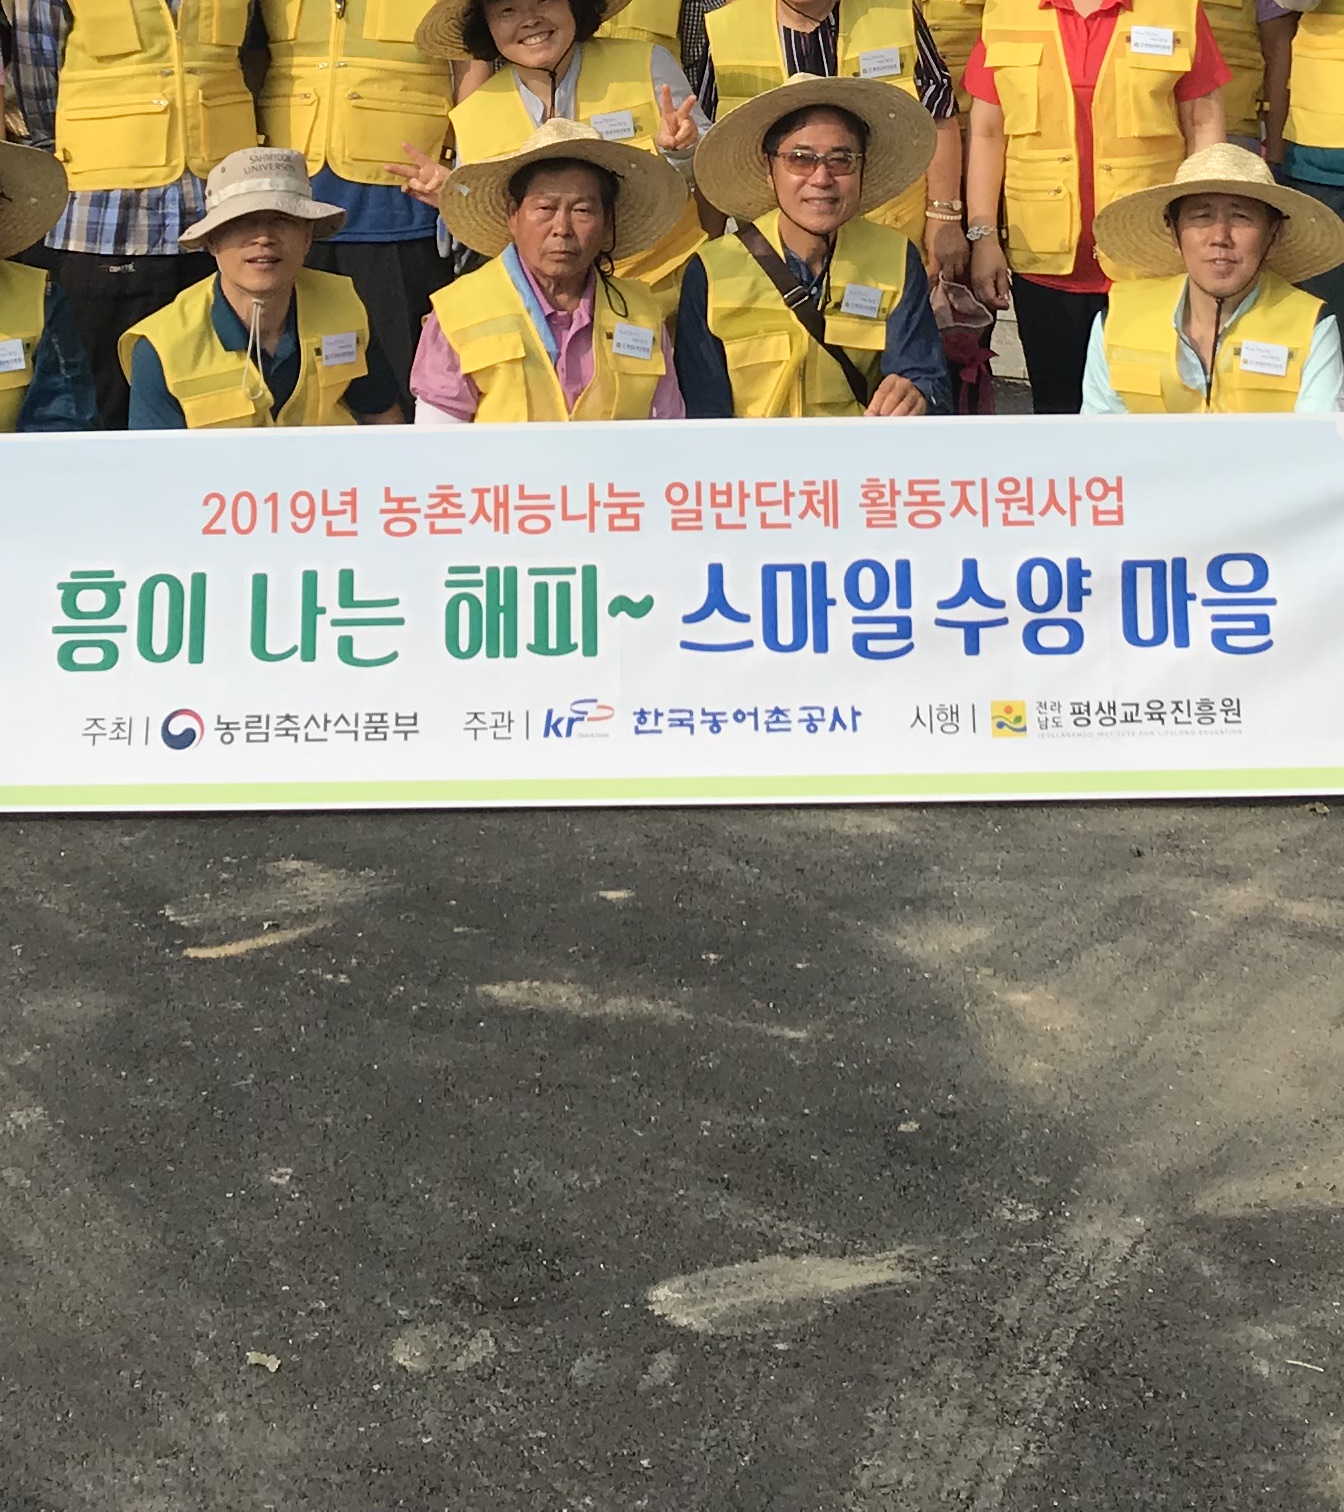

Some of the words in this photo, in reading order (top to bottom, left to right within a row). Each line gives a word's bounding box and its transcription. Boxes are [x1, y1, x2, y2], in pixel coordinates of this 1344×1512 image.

[202, 487, 358, 536] 2019년
[380, 483, 645, 537] 농촌재능나눔
[665, 479, 838, 531] 일반단체
[859, 476, 1123, 529] 활동지원사업
[52, 570, 206, 672] 흥이
[251, 569, 405, 667] 나는
[445, 565, 654, 660] 해피~
[680, 559, 914, 660] 스마일
[934, 557, 1092, 656] 수양
[1122, 553, 1277, 655] 마을
[82, 717, 132, 746] 주최
[214, 712, 419, 745] 농림축산식품부
[464, 711, 514, 741] 주관
[633, 706, 861, 735] 한국농어촌공사
[911, 704, 959, 734] 시행
[1070, 698, 1241, 727] 평생교육진흥원
